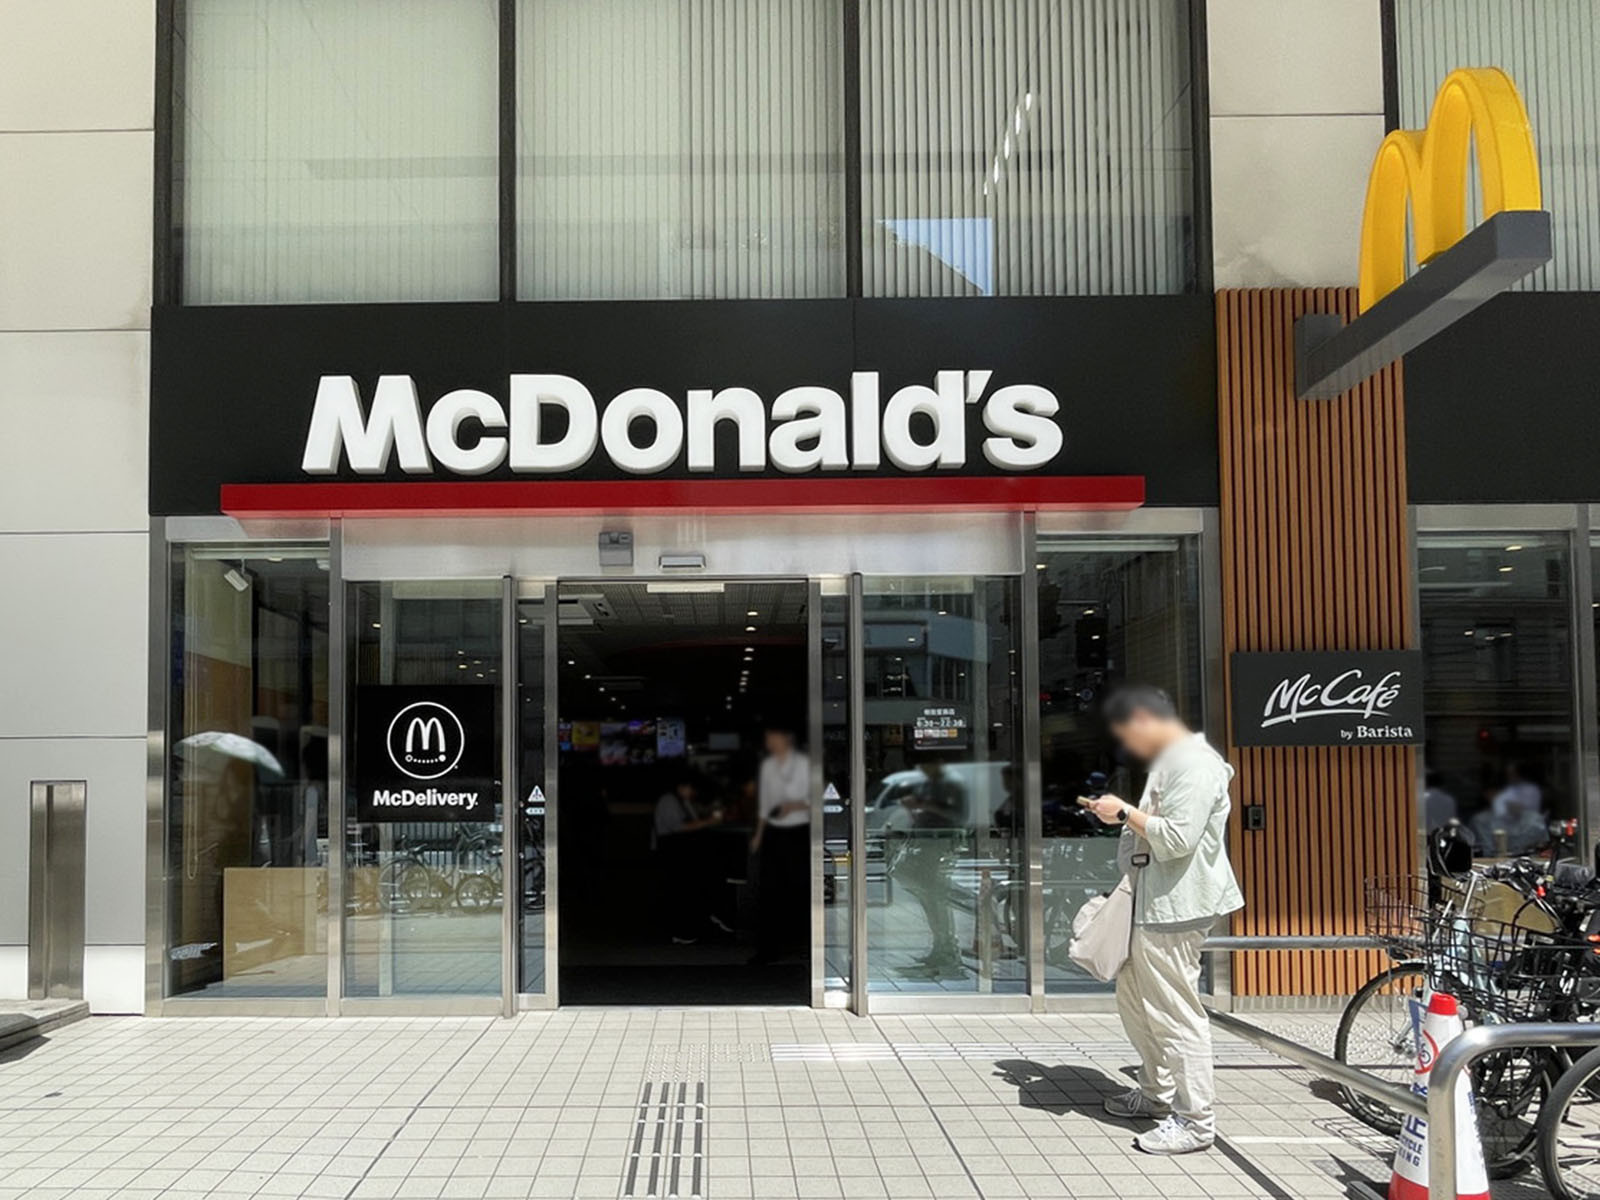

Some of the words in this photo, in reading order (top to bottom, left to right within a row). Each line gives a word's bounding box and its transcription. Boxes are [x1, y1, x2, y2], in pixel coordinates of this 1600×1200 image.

[302, 370, 1063, 475] McDonald's
[1263, 669, 1401, 723] McCafé
[1340, 729, 1353, 740] by
[1356, 725, 1413, 738] Barista
